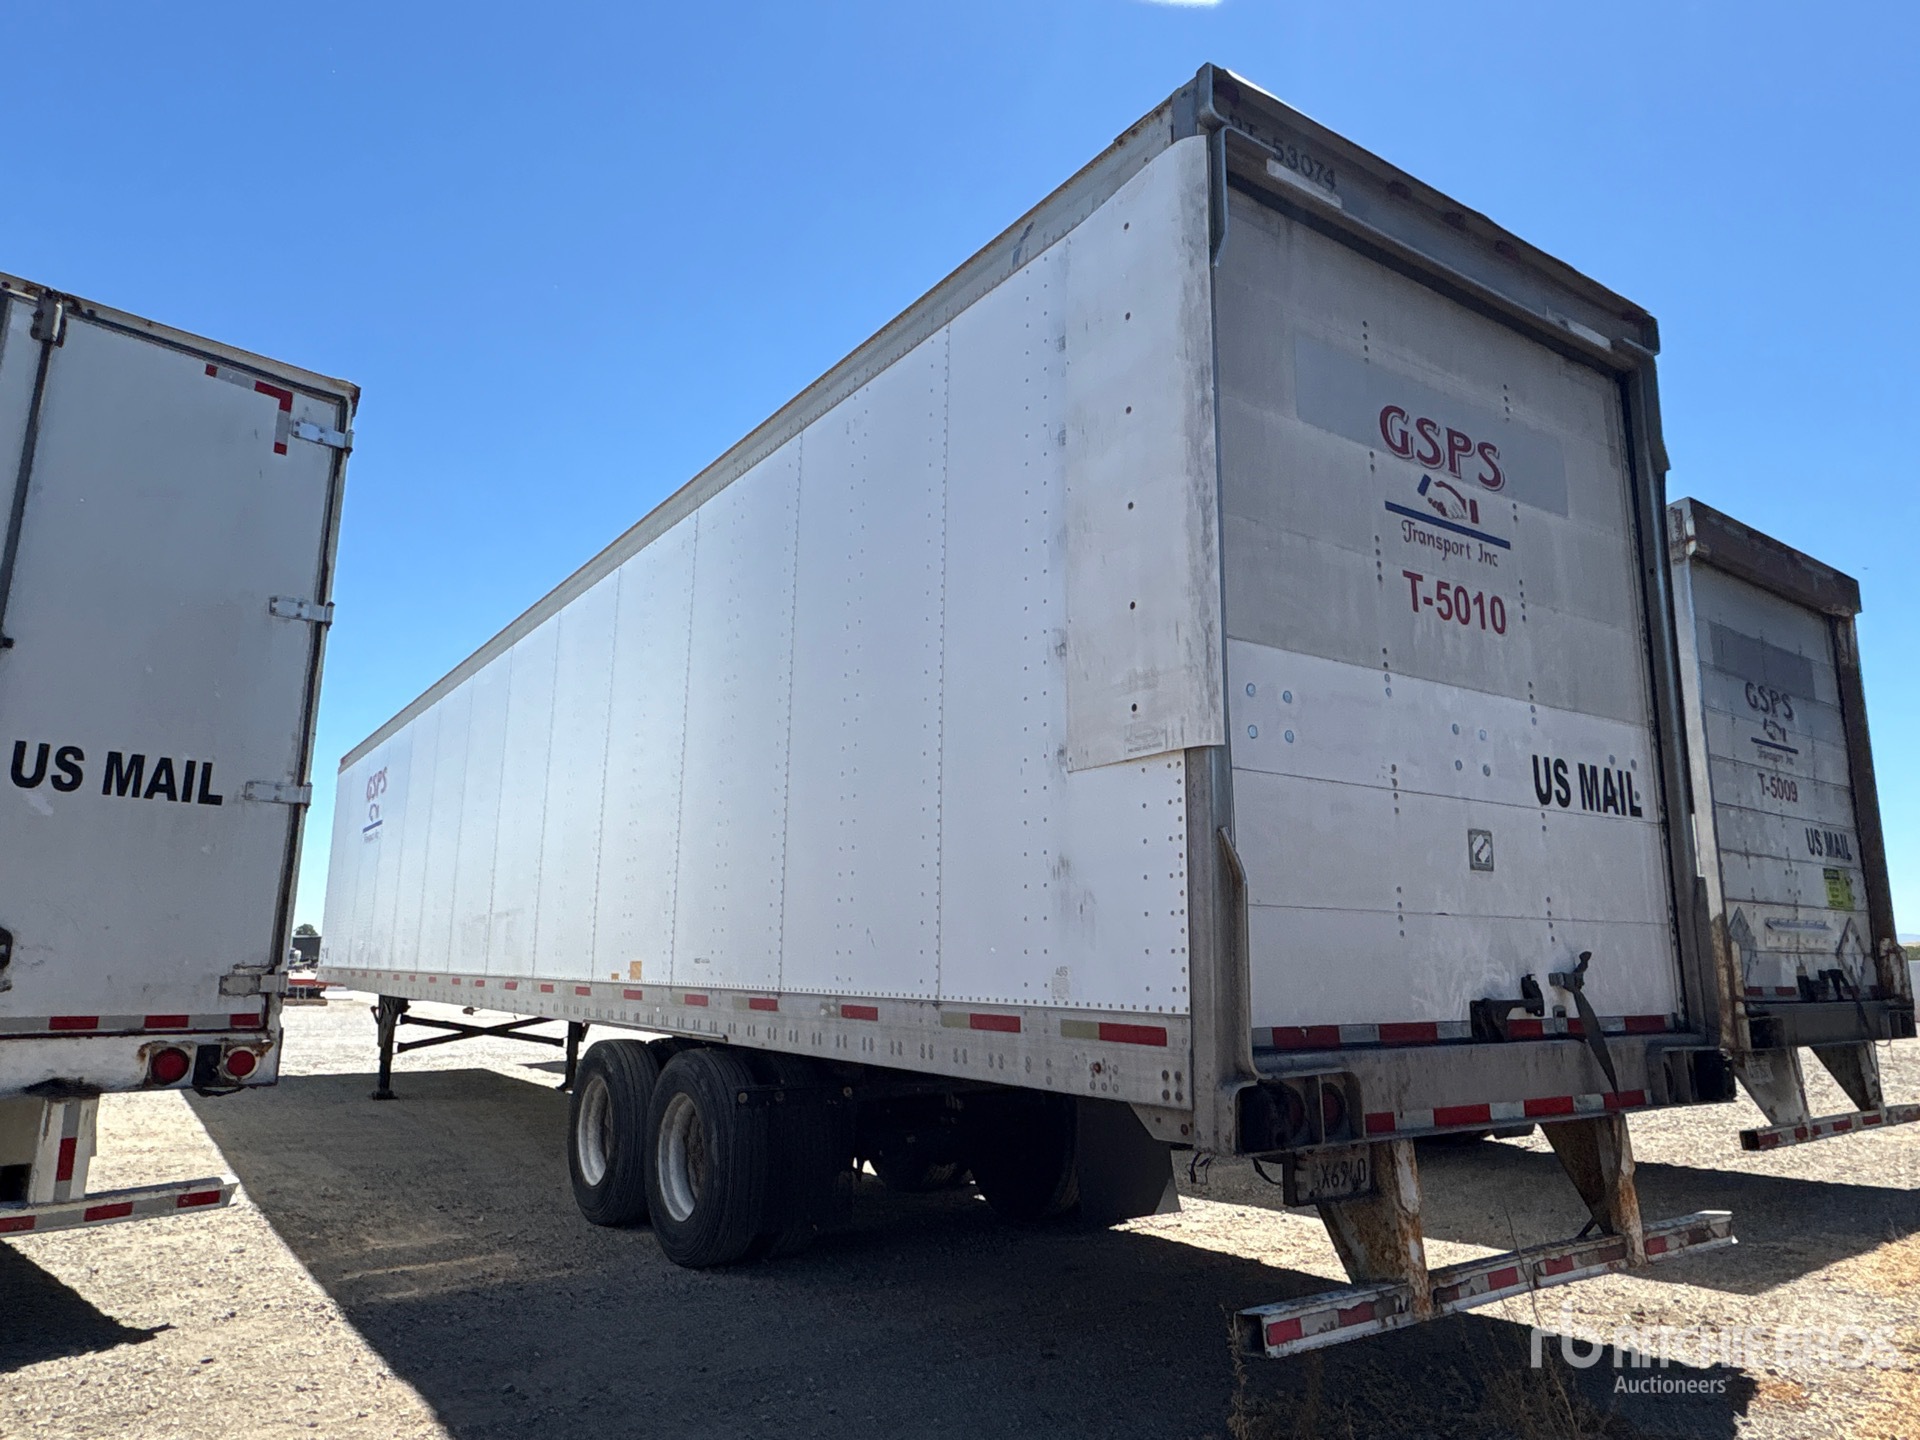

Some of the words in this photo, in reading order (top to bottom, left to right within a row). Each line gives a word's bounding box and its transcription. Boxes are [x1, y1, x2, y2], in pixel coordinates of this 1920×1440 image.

[1379, 405, 1505, 492] GSPS
[1401, 519, 1472, 561] Transport
[1477, 542, 1499, 568] Inc
[1402, 569, 1507, 635] T-5010
[1745, 681, 1794, 722] GSPS
[10, 740, 85, 793] US
[101, 751, 224, 807] MAIL
[1532, 754, 1571, 809] US
[1577, 762, 1643, 818] MAIL
[1757, 772, 1798, 803] T-5009
[1805, 827, 1824, 857] US
[1824, 829, 1853, 861] MAIL
